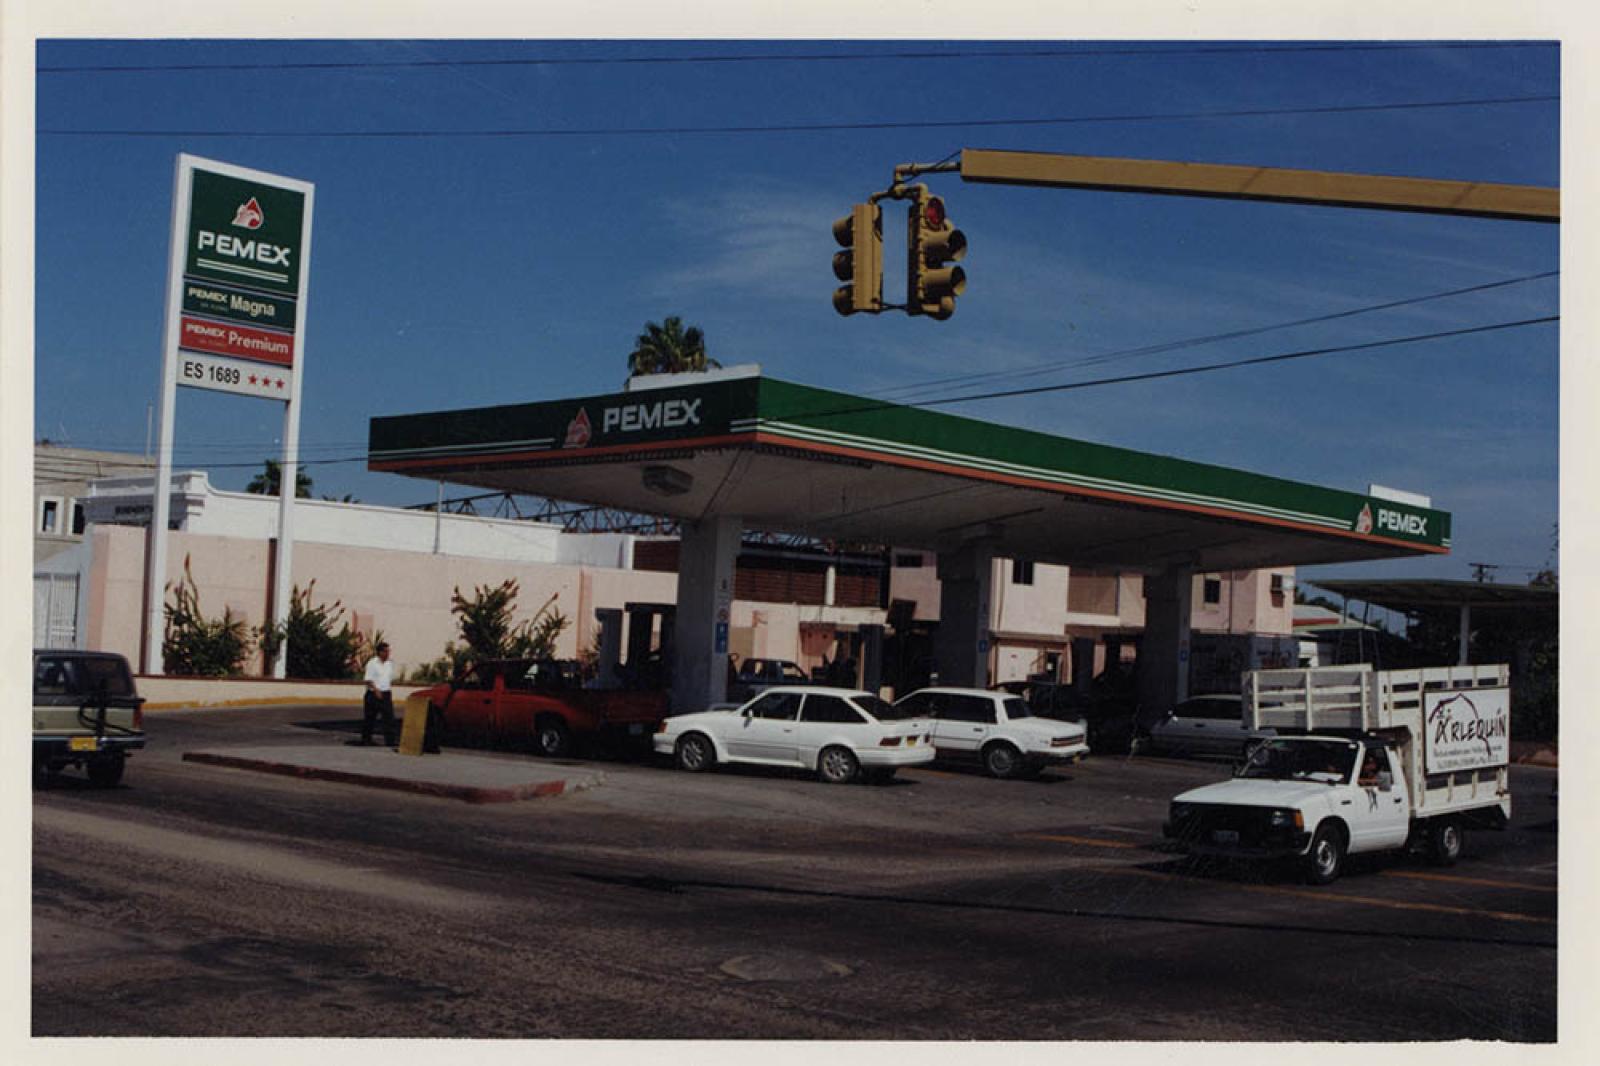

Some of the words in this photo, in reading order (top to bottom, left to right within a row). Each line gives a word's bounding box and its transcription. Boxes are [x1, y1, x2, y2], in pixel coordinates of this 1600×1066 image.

[197, 230, 291, 268] PEMEX
[188, 287, 229, 304] PEMEX
[230, 294, 276, 317] Magna
[185, 323, 226, 339] PEMEX
[227, 331, 289, 354] Premium
[183, 361, 204, 379] ES
[208, 366, 241, 385] 1689
[603, 398, 702, 433] PEMEX
[1377, 508, 1428, 537] PEMEX
